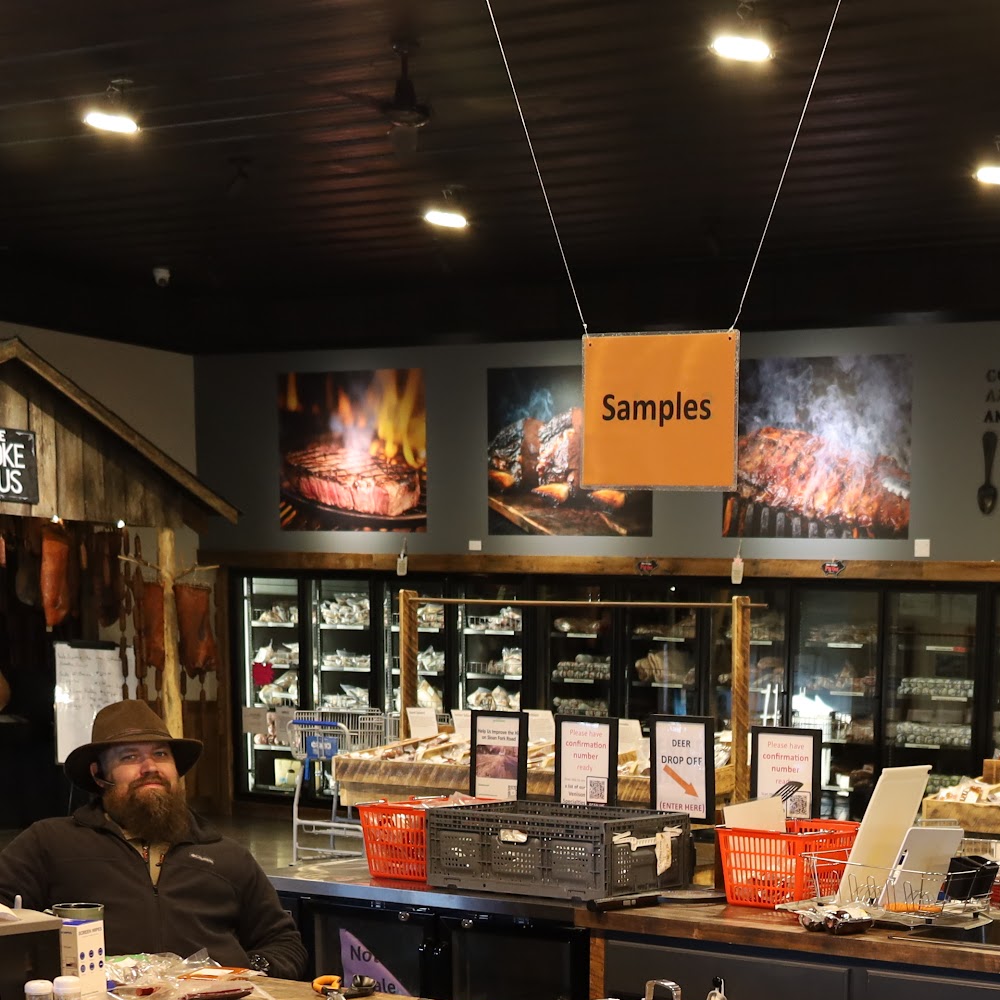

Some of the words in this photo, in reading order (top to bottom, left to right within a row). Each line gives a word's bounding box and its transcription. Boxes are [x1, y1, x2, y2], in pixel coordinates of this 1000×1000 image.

[602, 391, 711, 427] Samples
[0, 442, 26, 469] KE
[570, 729, 588, 737] Please
[565, 740, 607, 749] confirmation
[672, 739, 691, 748] DEER
[767, 741, 788, 749] Please
[789, 742, 805, 750] have
[573, 752, 599, 760] number
[661, 755, 684, 765] DROP
[686, 756, 702, 765] OFF
[762, 752, 809, 762] confirmation
[577, 764, 593, 773] ready
[771, 765, 800, 773] number
[659, 801, 683, 811] (ENTER
[684, 802, 705, 813] HERE)
[374, 978, 396, 994] ale
